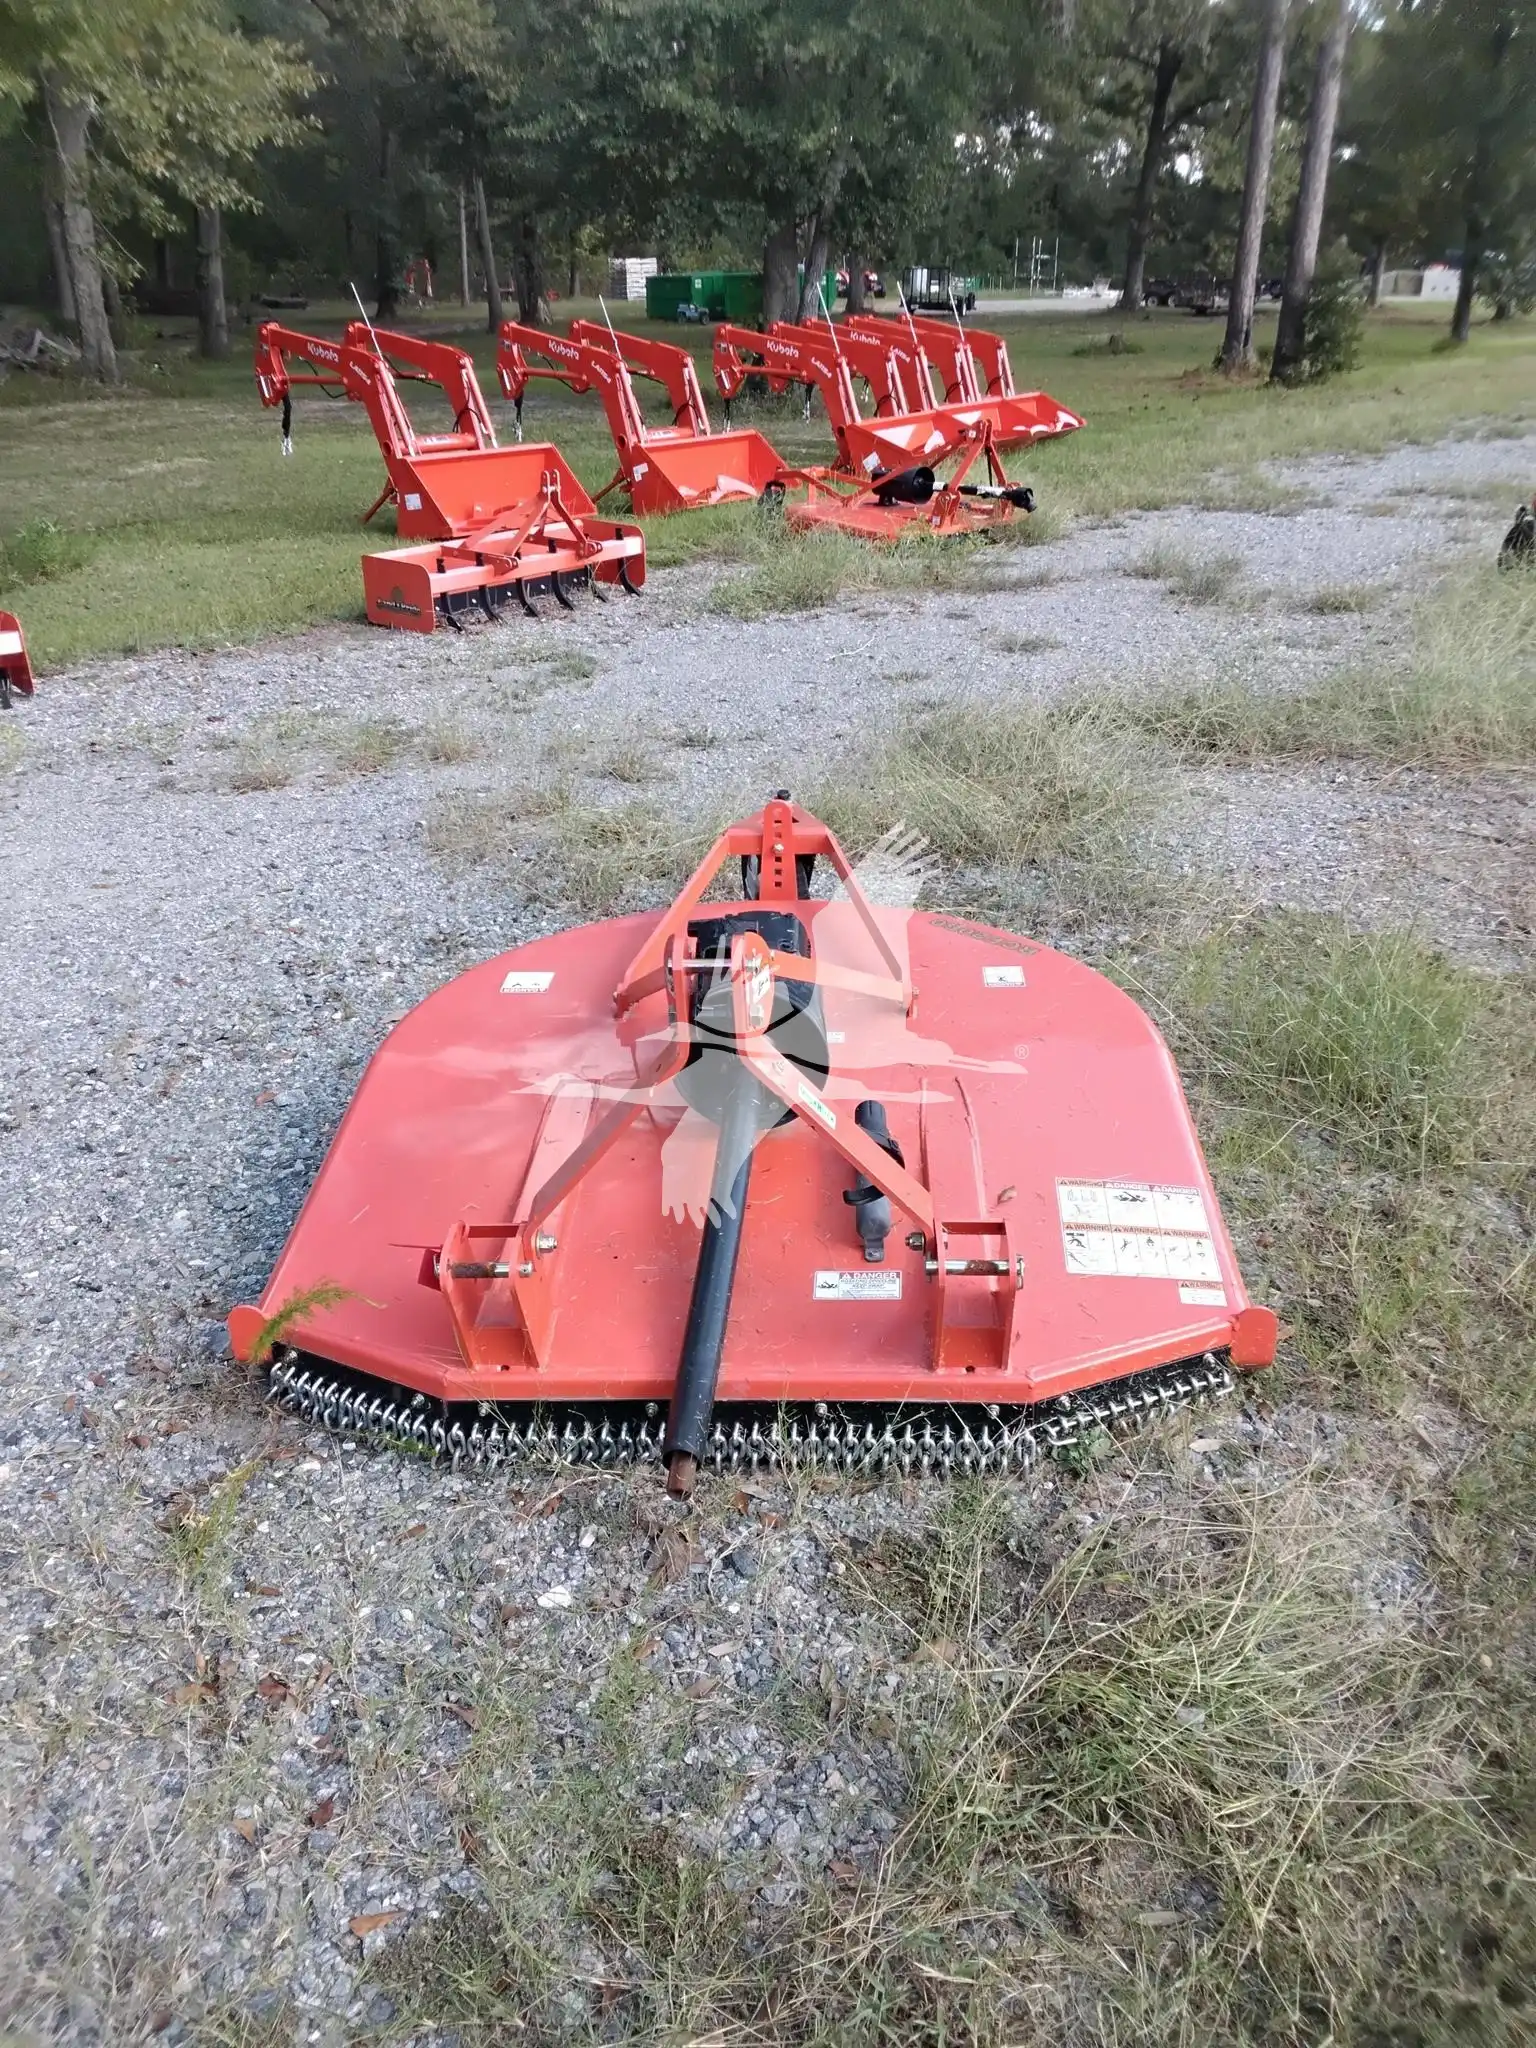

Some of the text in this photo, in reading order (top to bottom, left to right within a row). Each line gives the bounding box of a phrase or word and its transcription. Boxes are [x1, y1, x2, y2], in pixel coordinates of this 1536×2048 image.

[850, 331, 881, 346] Kubota
[307, 341, 339, 362] Kubota
[548, 339, 580, 361] Kubota
[766, 339, 799, 358] Kubota
[1114, 1182, 1150, 1191] DANGER
[1073, 1224, 1110, 1232] WARNING
[1121, 1226, 1158, 1234] WARNING
[1171, 1230, 1208, 1238] WARNING
